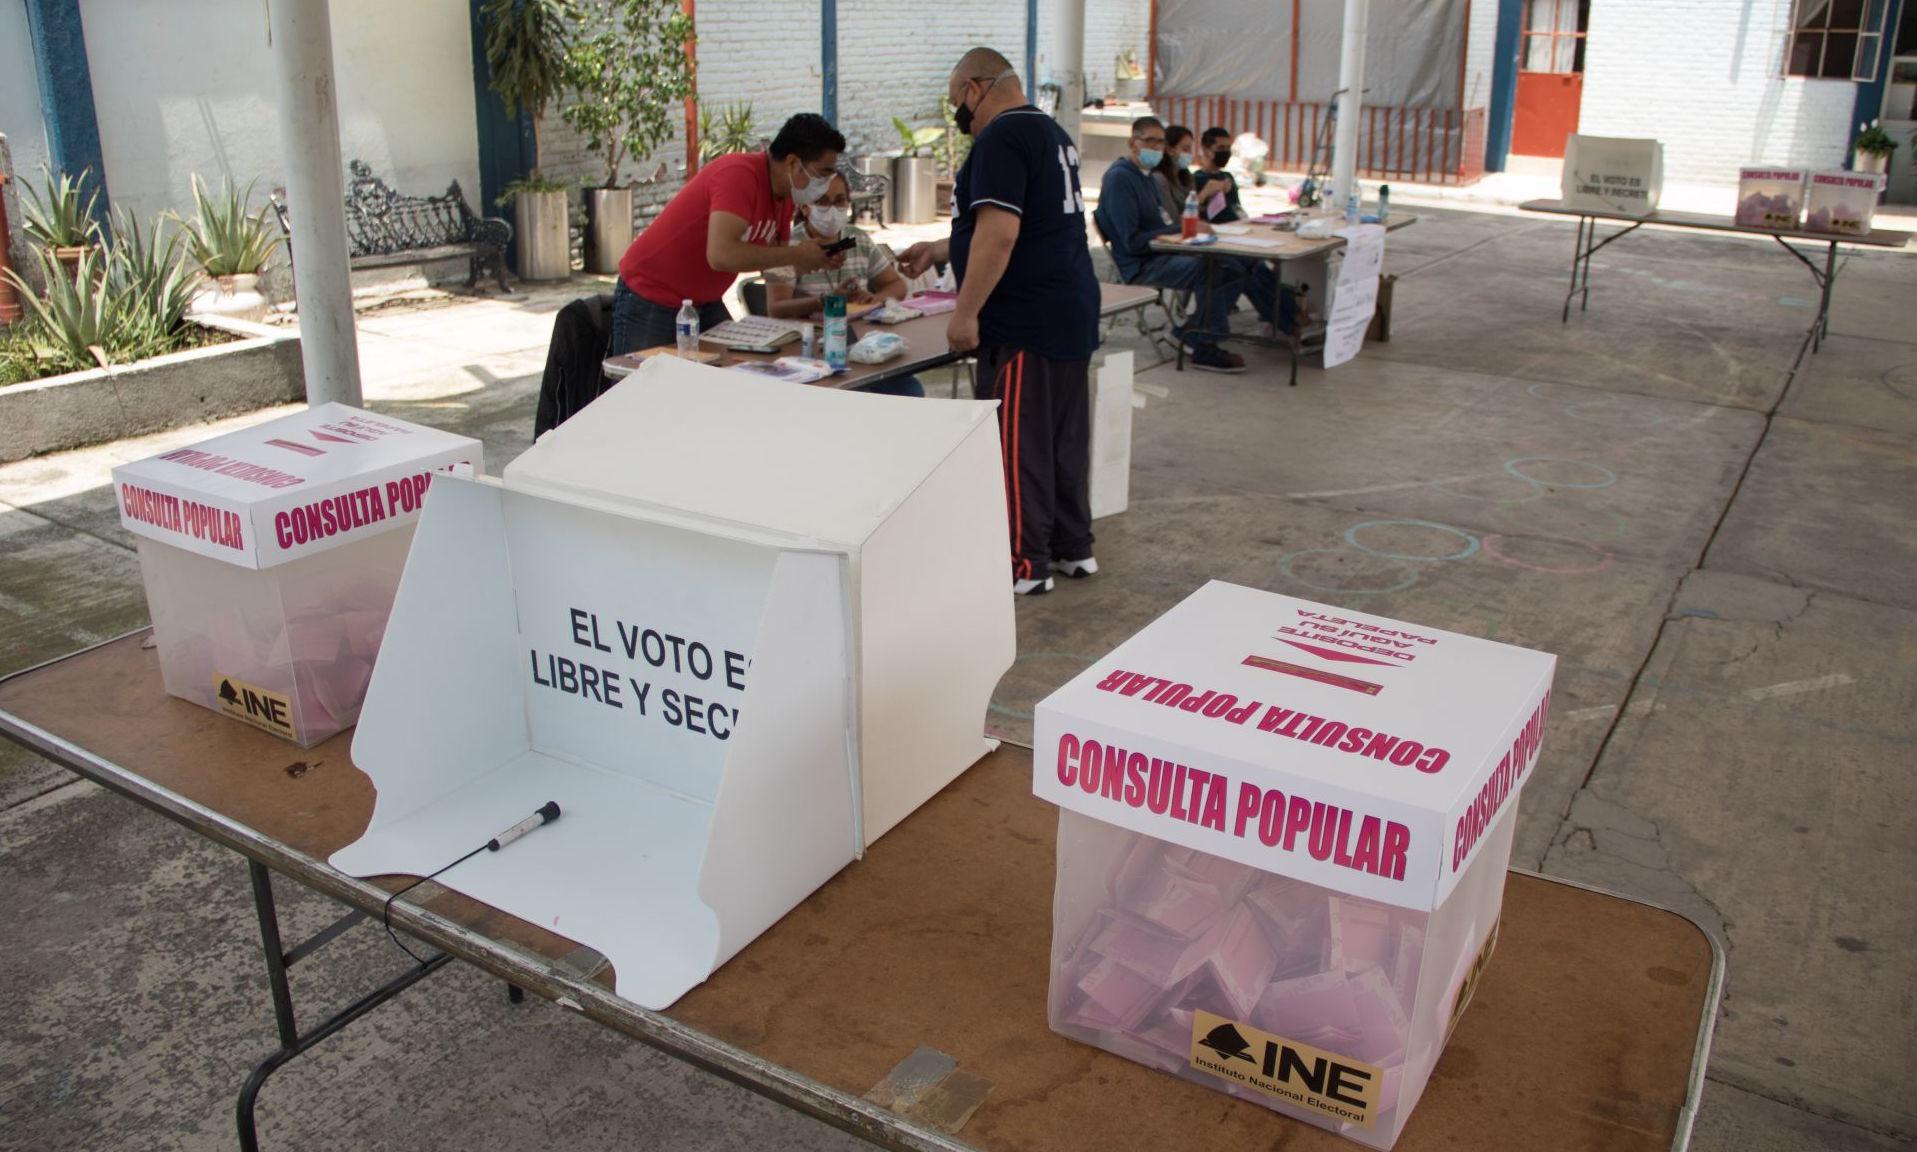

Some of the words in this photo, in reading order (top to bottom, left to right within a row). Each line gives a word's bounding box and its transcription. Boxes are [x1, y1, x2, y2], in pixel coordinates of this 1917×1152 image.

[121, 483, 182, 533] CONSULTA
[182, 499, 244, 551] POPULAR
[275, 486, 386, 550] CONSULTA
[570, 607, 612, 654] EL
[616, 620, 713, 681] VOTO
[724, 650, 752, 691] E
[1276, 626, 1417, 662] DEPOSITE
[1296, 607, 1439, 645] PAPELETA
[1298, 620, 1339, 633] SU
[241, 688, 291, 729] INE
[531, 648, 624, 709] LIBRE
[629, 677, 651, 716] Y
[661, 688, 739, 741] SEC
[1096, 669, 1263, 725] POPULAR
[1256, 705, 1451, 774] CONSULTA
[1057, 733, 1228, 832] CONSULTA
[1233, 781, 1411, 882] POPULAR
[1452, 750, 1511, 873] CONSULTA
[1195, 1055, 1246, 1081] Instituto
[1249, 1075, 1304, 1102] Nacional
[1307, 1096, 1365, 1123] Electoral
[1262, 1040, 1372, 1110] INE
